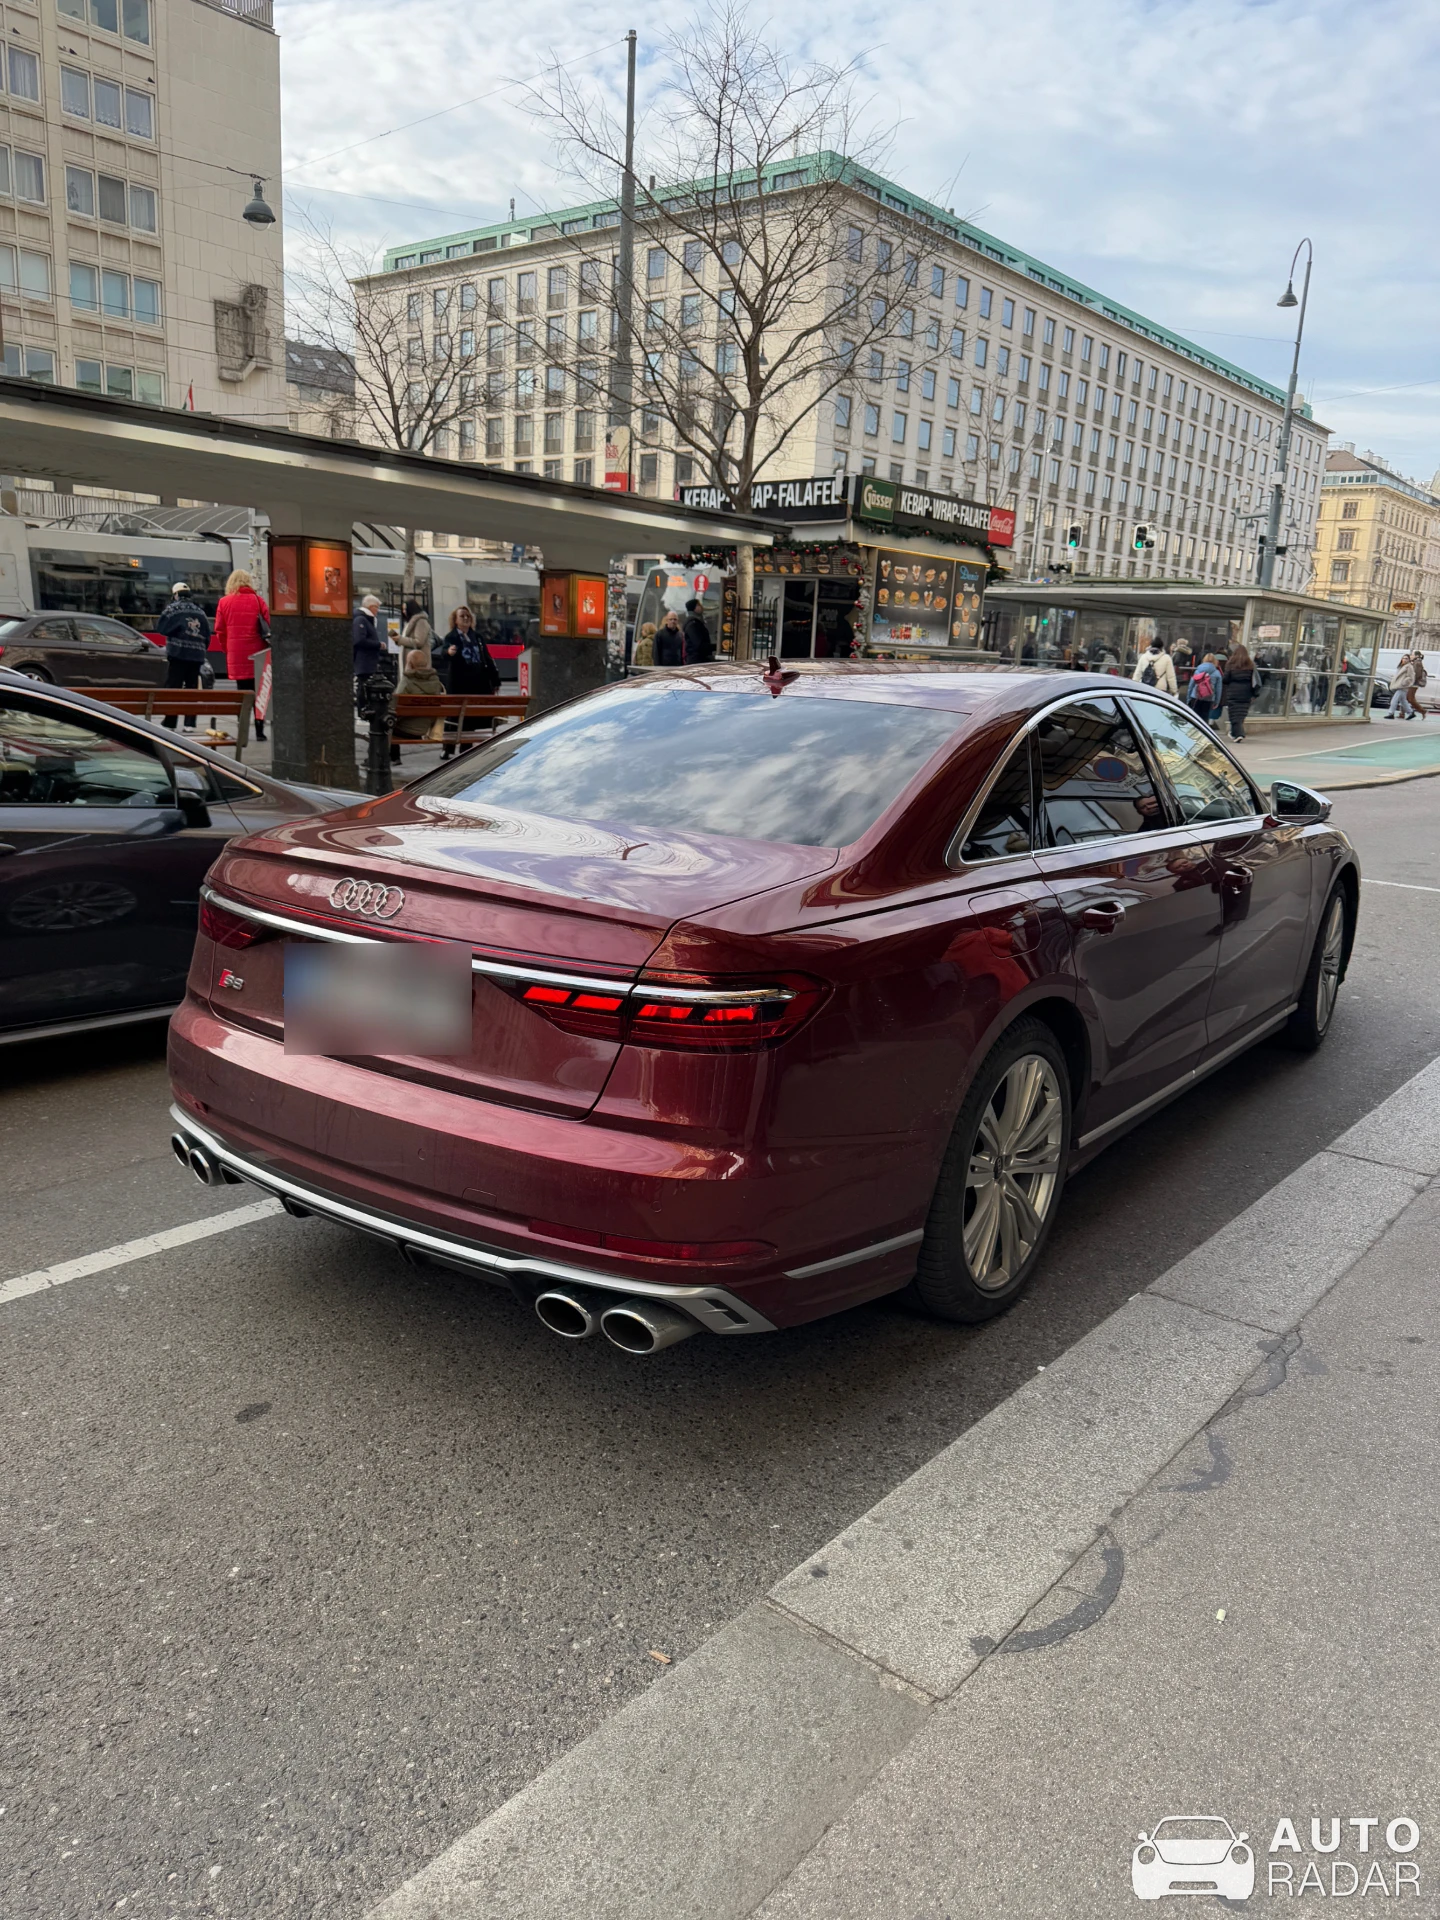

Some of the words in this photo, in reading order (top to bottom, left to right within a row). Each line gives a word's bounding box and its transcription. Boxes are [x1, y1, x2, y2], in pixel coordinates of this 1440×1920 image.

[778, 480, 840, 508] FALAFEL
[863, 483, 893, 511] Gösser
[900, 490, 930, 517] KEBAP
[933, 498, 958, 523] WRAP
[959, 505, 991, 531] FALAFEL
